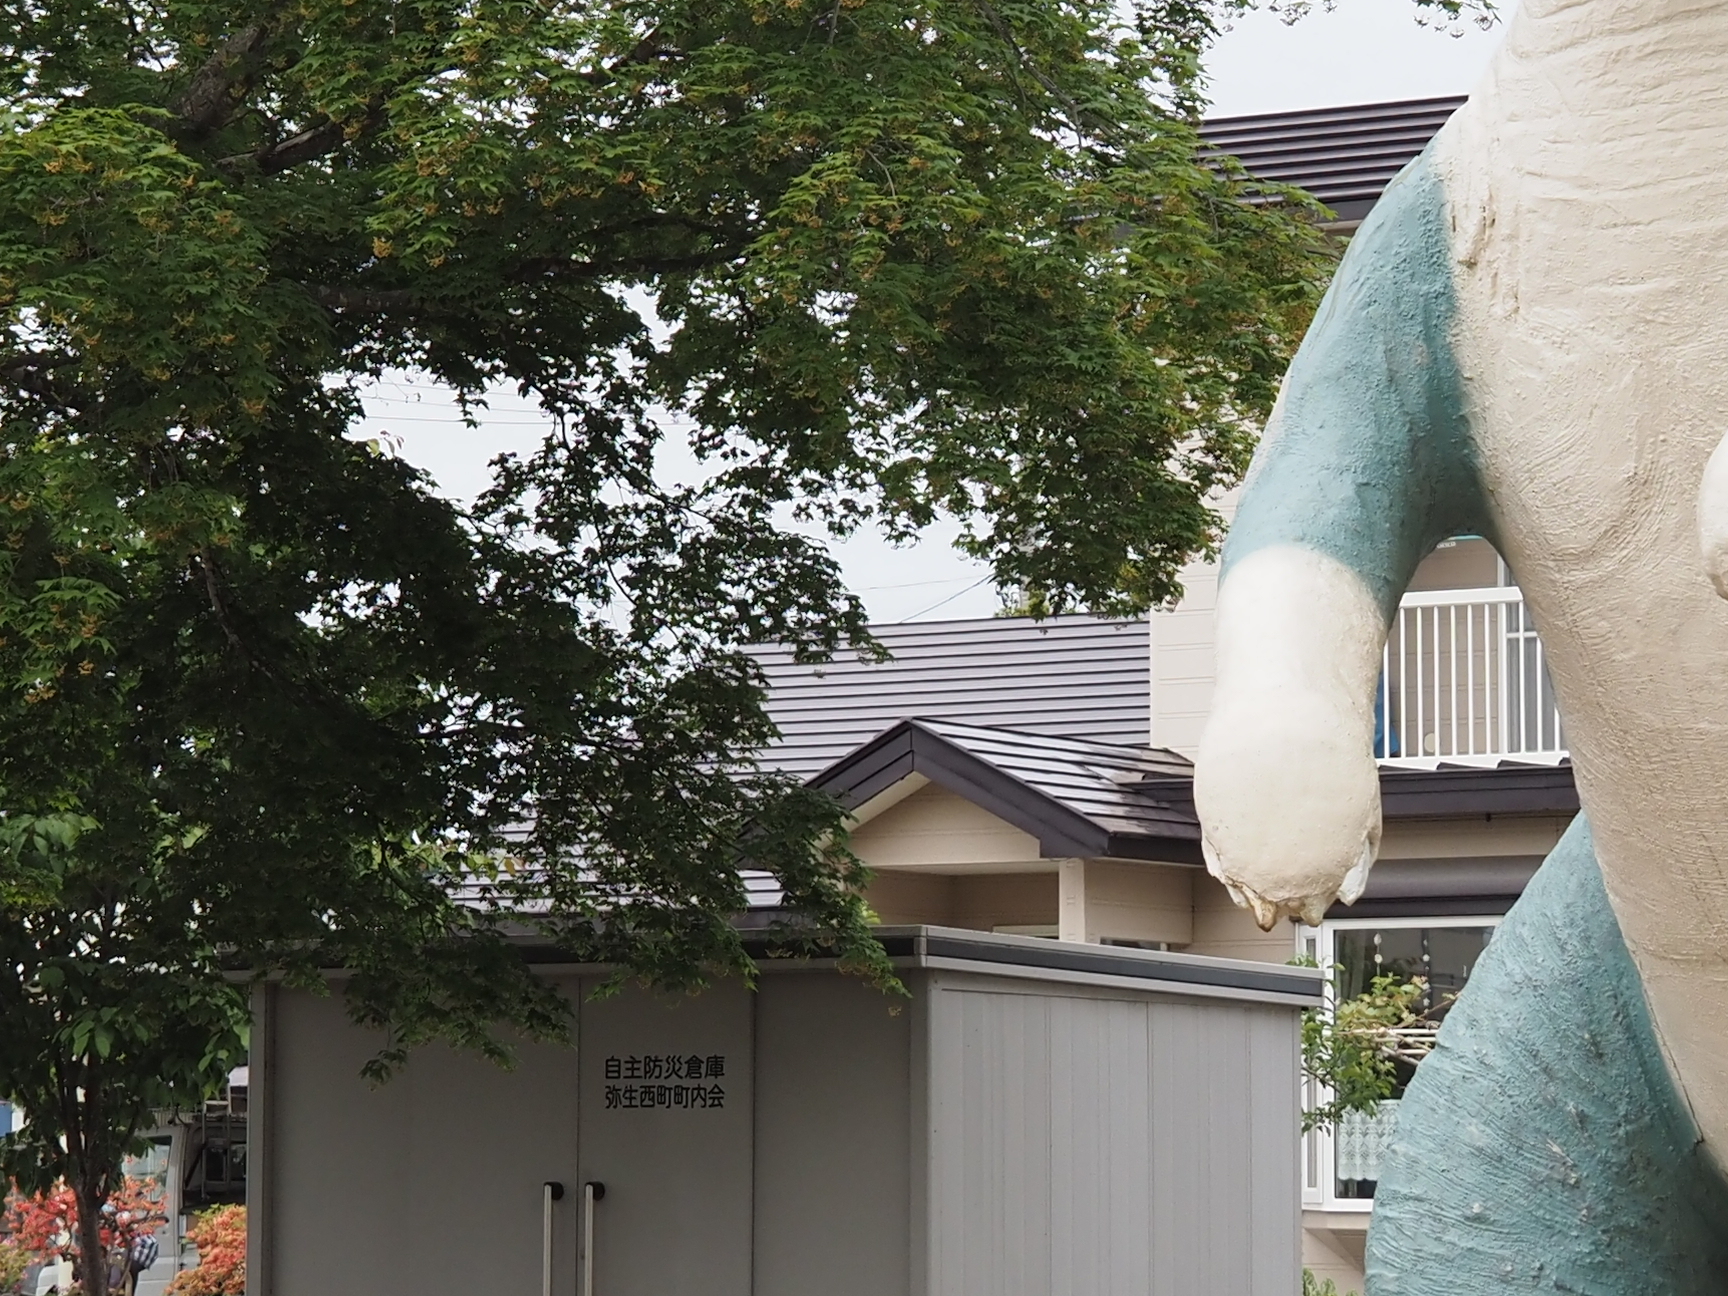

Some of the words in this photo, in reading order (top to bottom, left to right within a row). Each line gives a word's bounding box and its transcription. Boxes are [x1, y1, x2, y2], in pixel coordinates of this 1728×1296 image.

[604, 1055, 725, 1080] 自主防災倉庫
[604, 1083, 725, 1109] 弥生西町町内会
